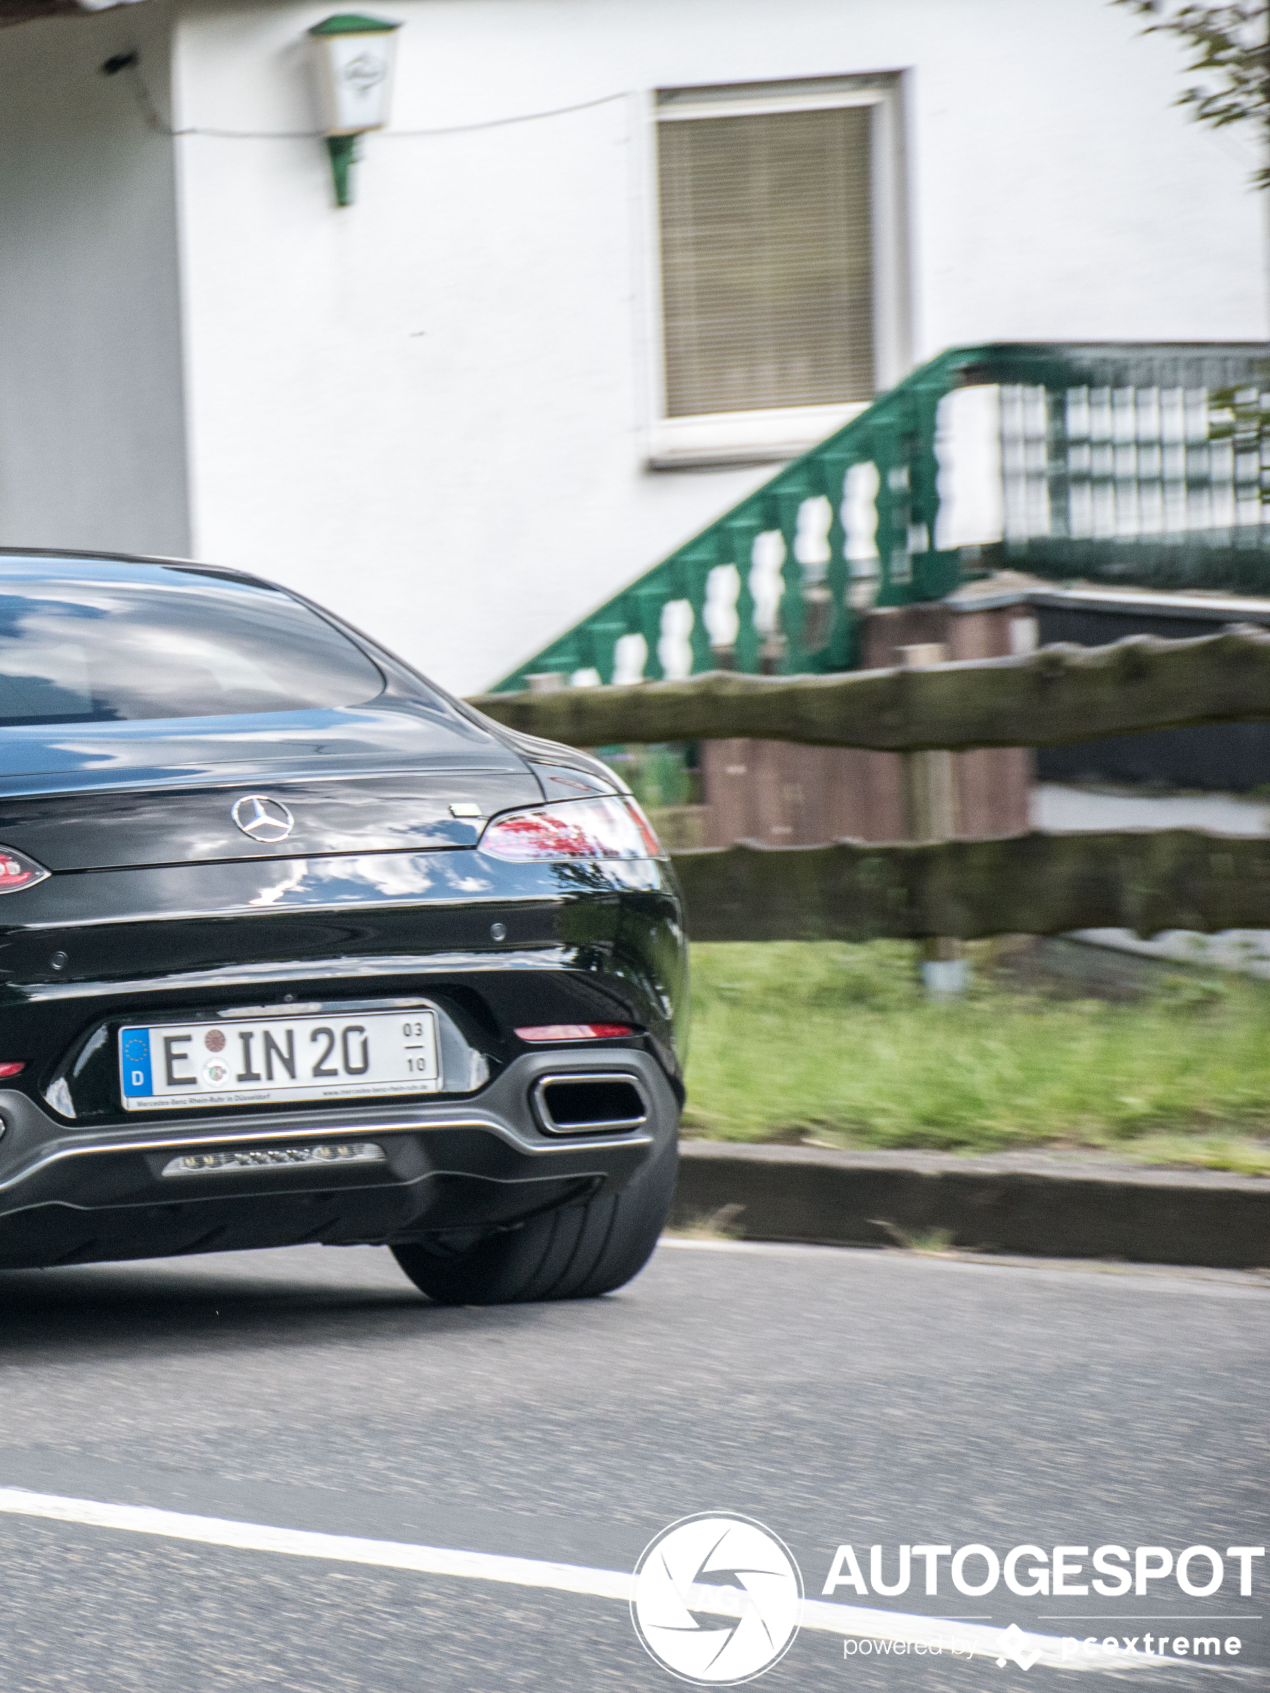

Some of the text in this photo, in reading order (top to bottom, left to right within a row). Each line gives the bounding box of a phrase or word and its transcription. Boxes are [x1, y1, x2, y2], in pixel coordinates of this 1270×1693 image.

[403, 1022, 423, 1037] 03
[163, 1034, 197, 1086] E
[131, 1070, 145, 1086] D
